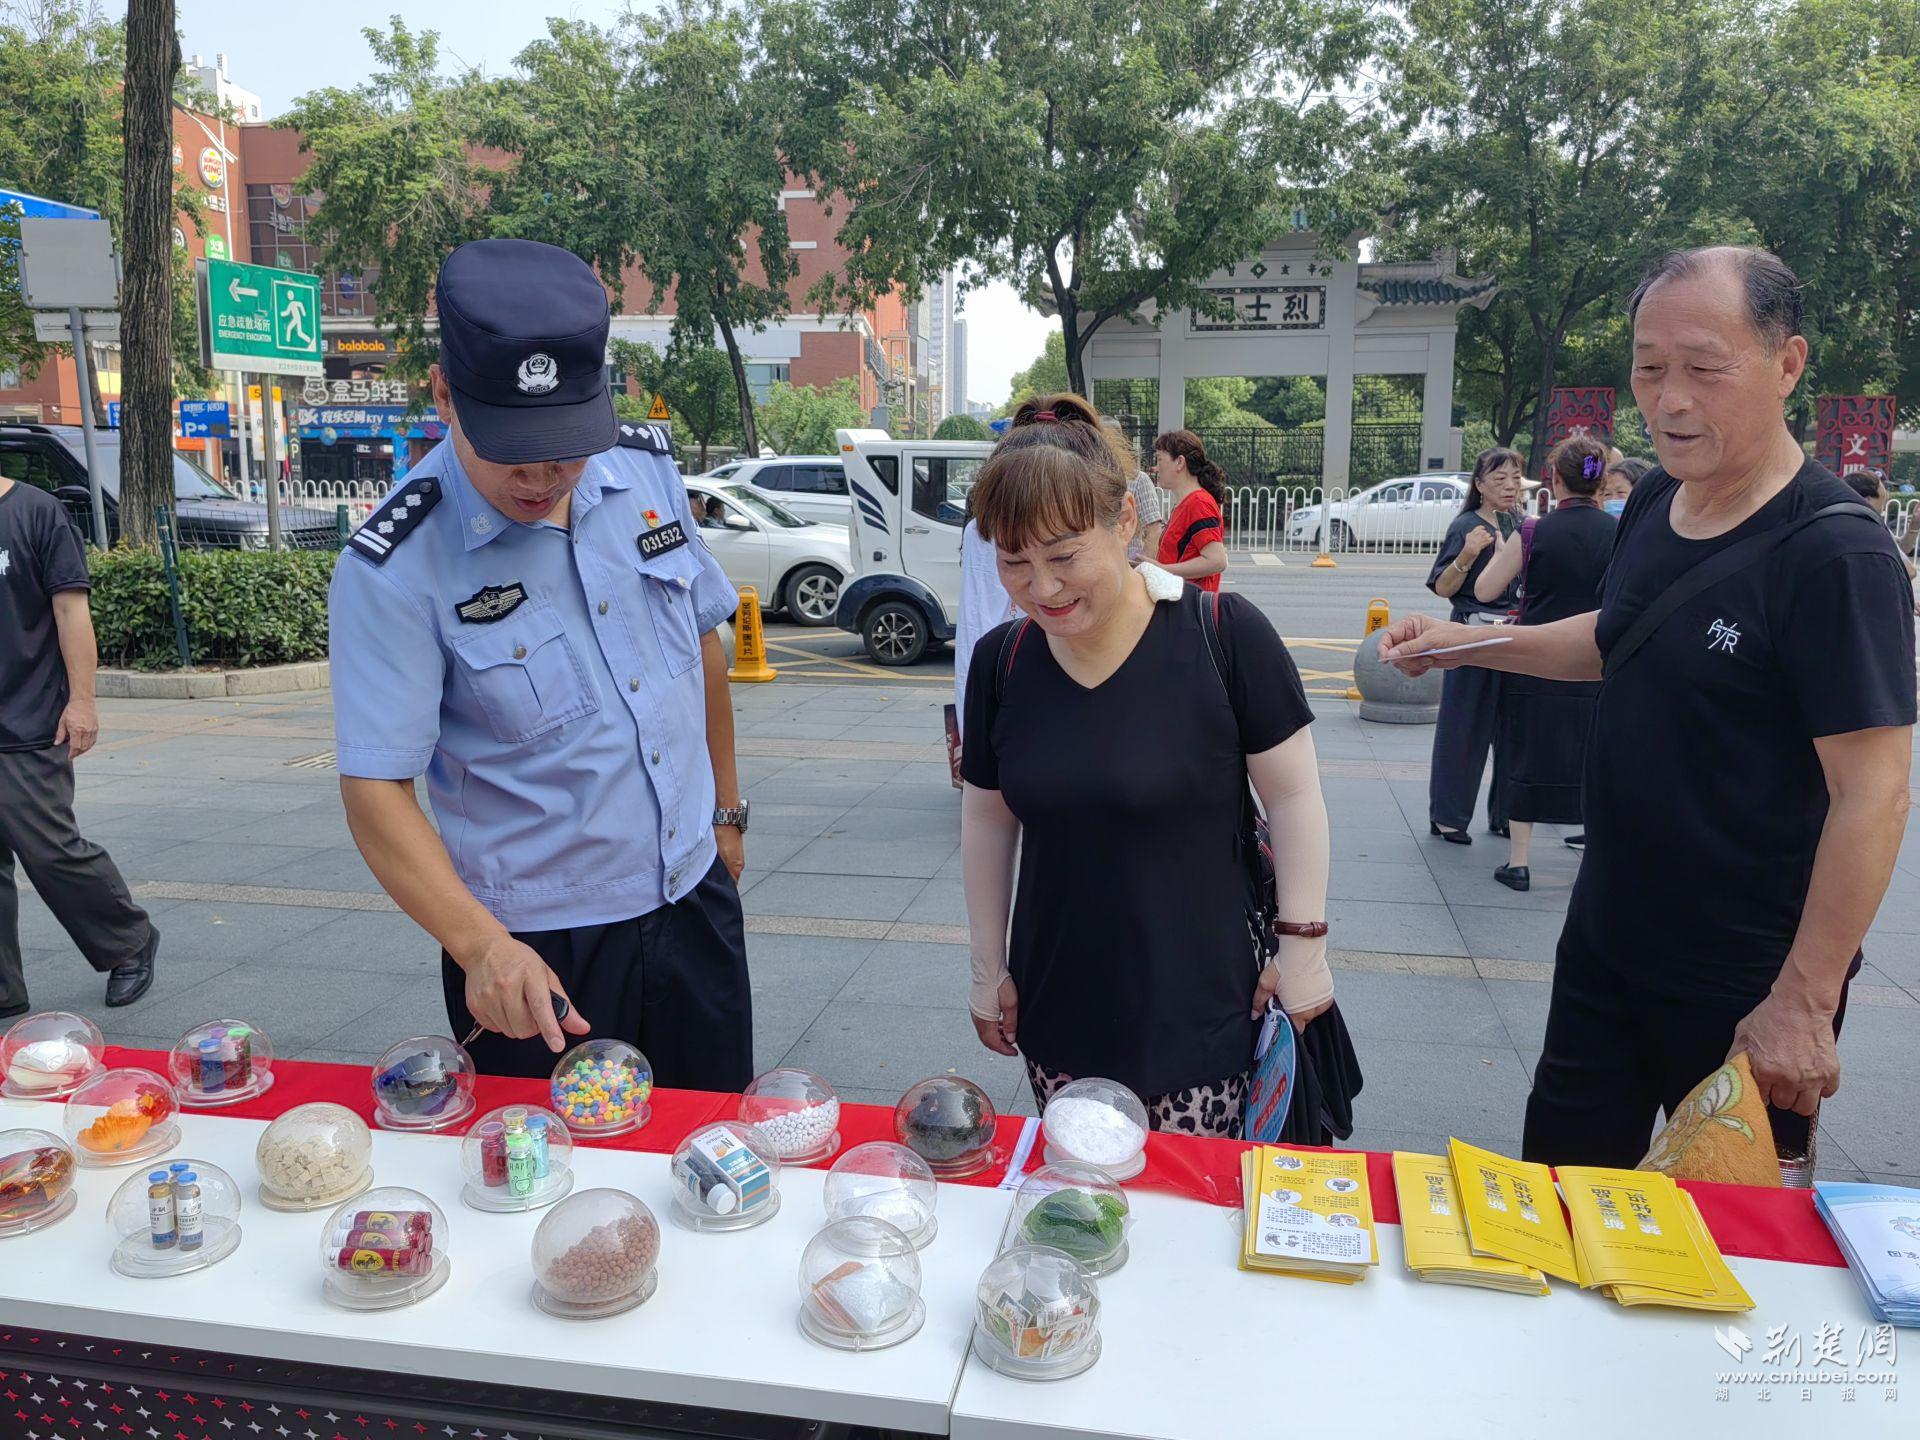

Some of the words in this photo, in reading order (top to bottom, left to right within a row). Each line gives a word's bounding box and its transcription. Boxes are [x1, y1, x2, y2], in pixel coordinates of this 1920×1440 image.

[204, 165, 222, 176] KING
[219, 315, 271, 333] 应急疏散场所
[218, 330, 245, 339] EMERGENCY
[246, 333, 271, 342] EVACUATION
[338, 340, 385, 351] balabala
[332, 380, 409, 402] 盒马鲜生
[366, 415, 383, 424] KTV
[641, 527, 683, 553] 031532
